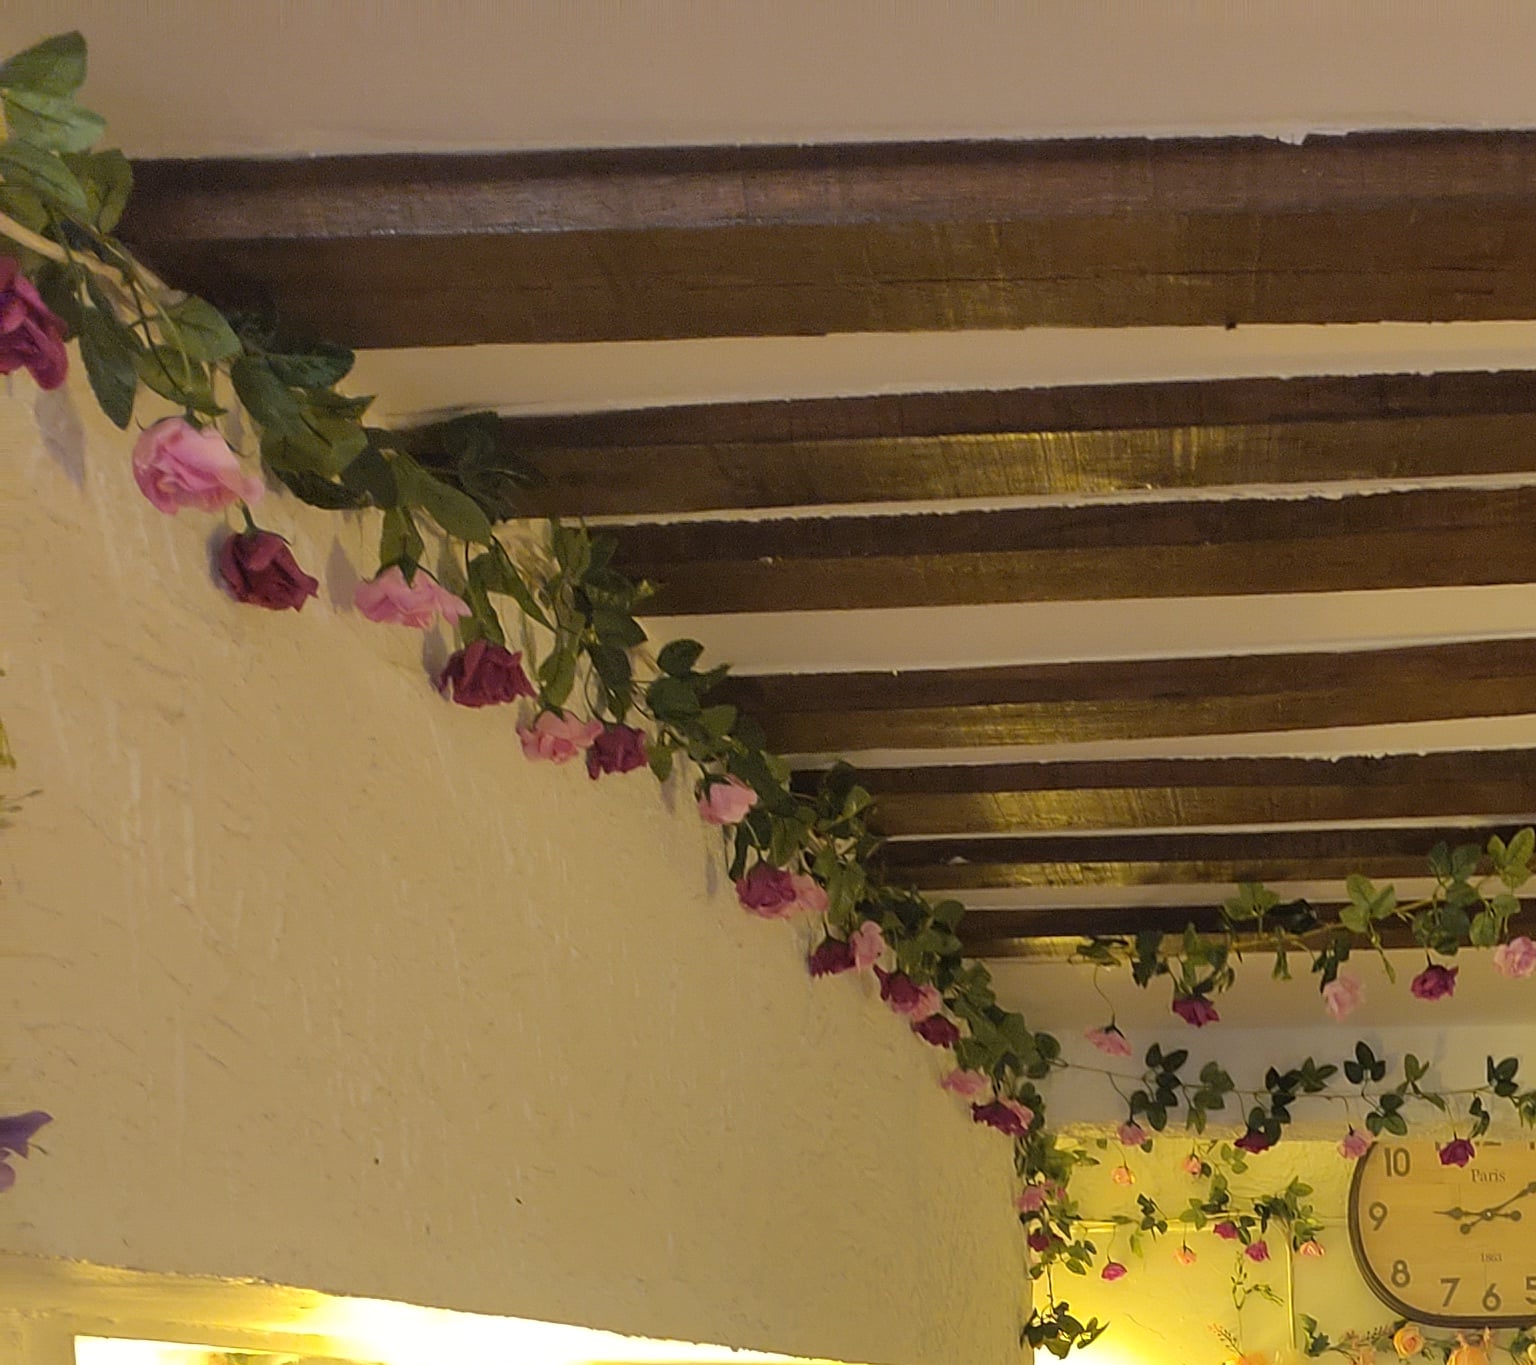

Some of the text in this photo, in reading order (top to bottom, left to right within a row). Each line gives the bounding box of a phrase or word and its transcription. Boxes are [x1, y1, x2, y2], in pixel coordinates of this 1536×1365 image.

[1384, 1147, 1411, 1177] 10
[1471, 1168, 1506, 1183] Paris
[1368, 1202, 1387, 1231] 9
[1391, 1260, 1411, 1288] 8
[1440, 1278, 1461, 1307] 7
[1482, 1283, 1501, 1312] 6
